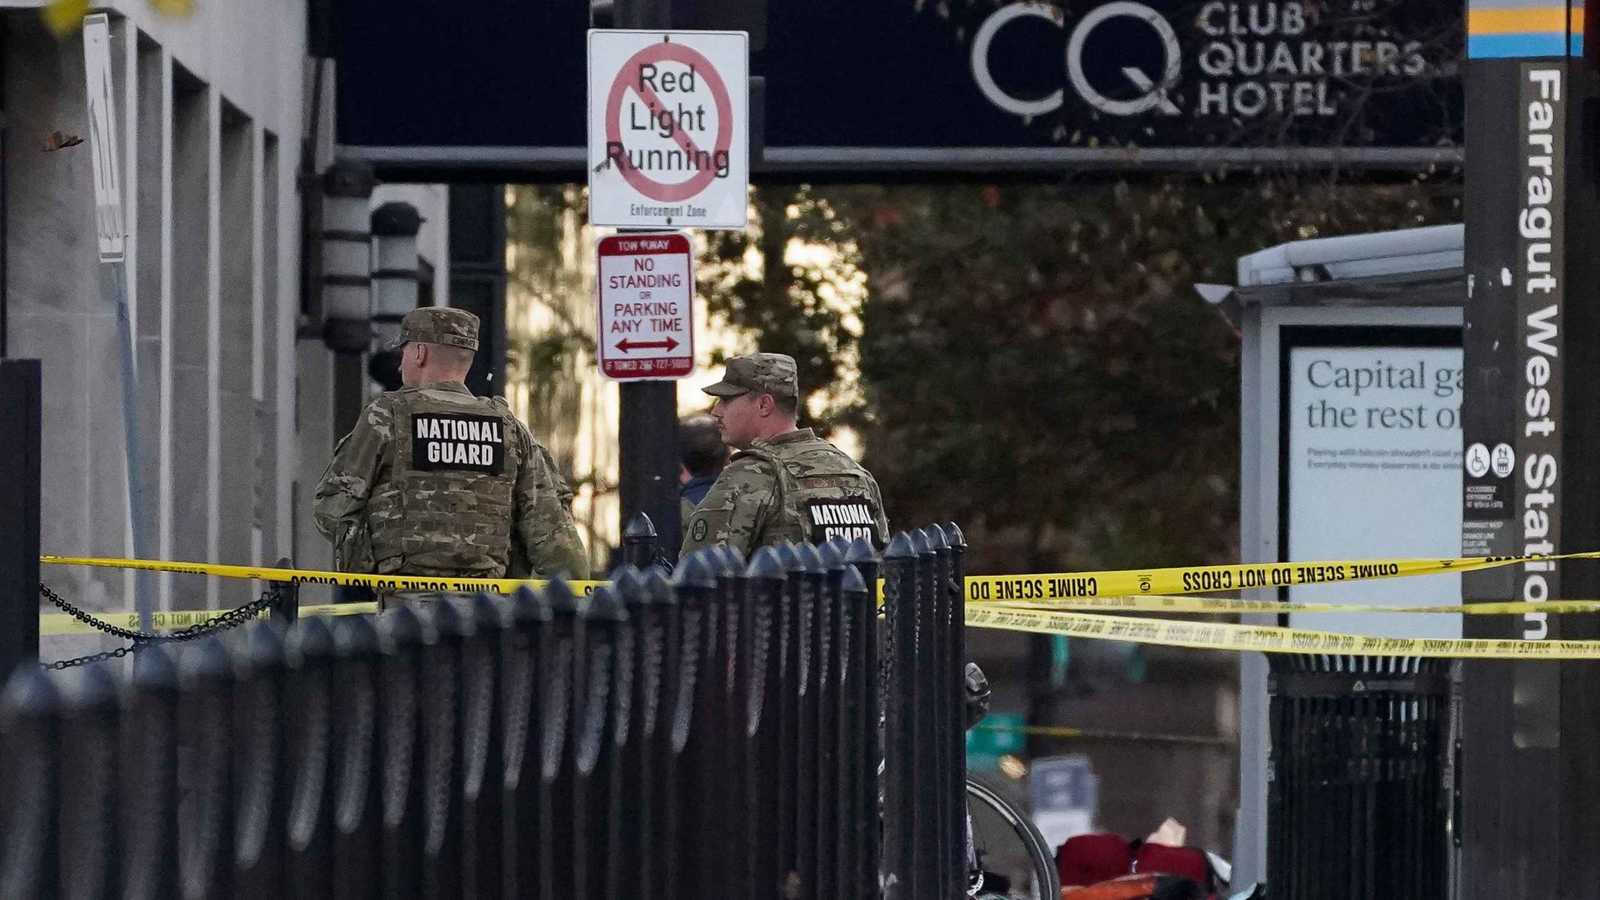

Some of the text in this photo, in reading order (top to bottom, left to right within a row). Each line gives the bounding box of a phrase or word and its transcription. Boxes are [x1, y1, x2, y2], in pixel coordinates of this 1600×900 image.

[1199, 1, 1305, 36] CLUB
[972, 0, 1181, 115] CQ
[1199, 40, 1425, 77] QUARTERS
[639, 63, 695, 93] Red
[1200, 81, 1336, 116] HOTEL
[631, 102, 706, 138] Light
[606, 141, 730, 178] Running
[630, 203, 707, 217] Enforcement Zone
[618, 240, 638, 251] TOW
[634, 258, 655, 272] NO
[609, 274, 681, 290] STANDING
[640, 291, 652, 300] OR
[614, 302, 678, 317] PARKING
[611, 318, 683, 334] ANY TIME
[1519, 69, 1561, 639] Farragut West Station
[1307, 360, 1425, 396] Capital
[1307, 400, 1464, 429] the rest o
[417, 418, 503, 443] NATIONAL
[428, 441, 494, 466] GUARD
[810, 504, 874, 525] NATIONAL
[1183, 570, 1232, 591] CROSS
[1238, 568, 1266, 588] NOT
[1272, 567, 1292, 585] DO
[1297, 565, 1345, 584] SCENE
[970, 581, 990, 600] DO
[995, 579, 1043, 599] SCENE
[1048, 577, 1097, 598] CRIME
